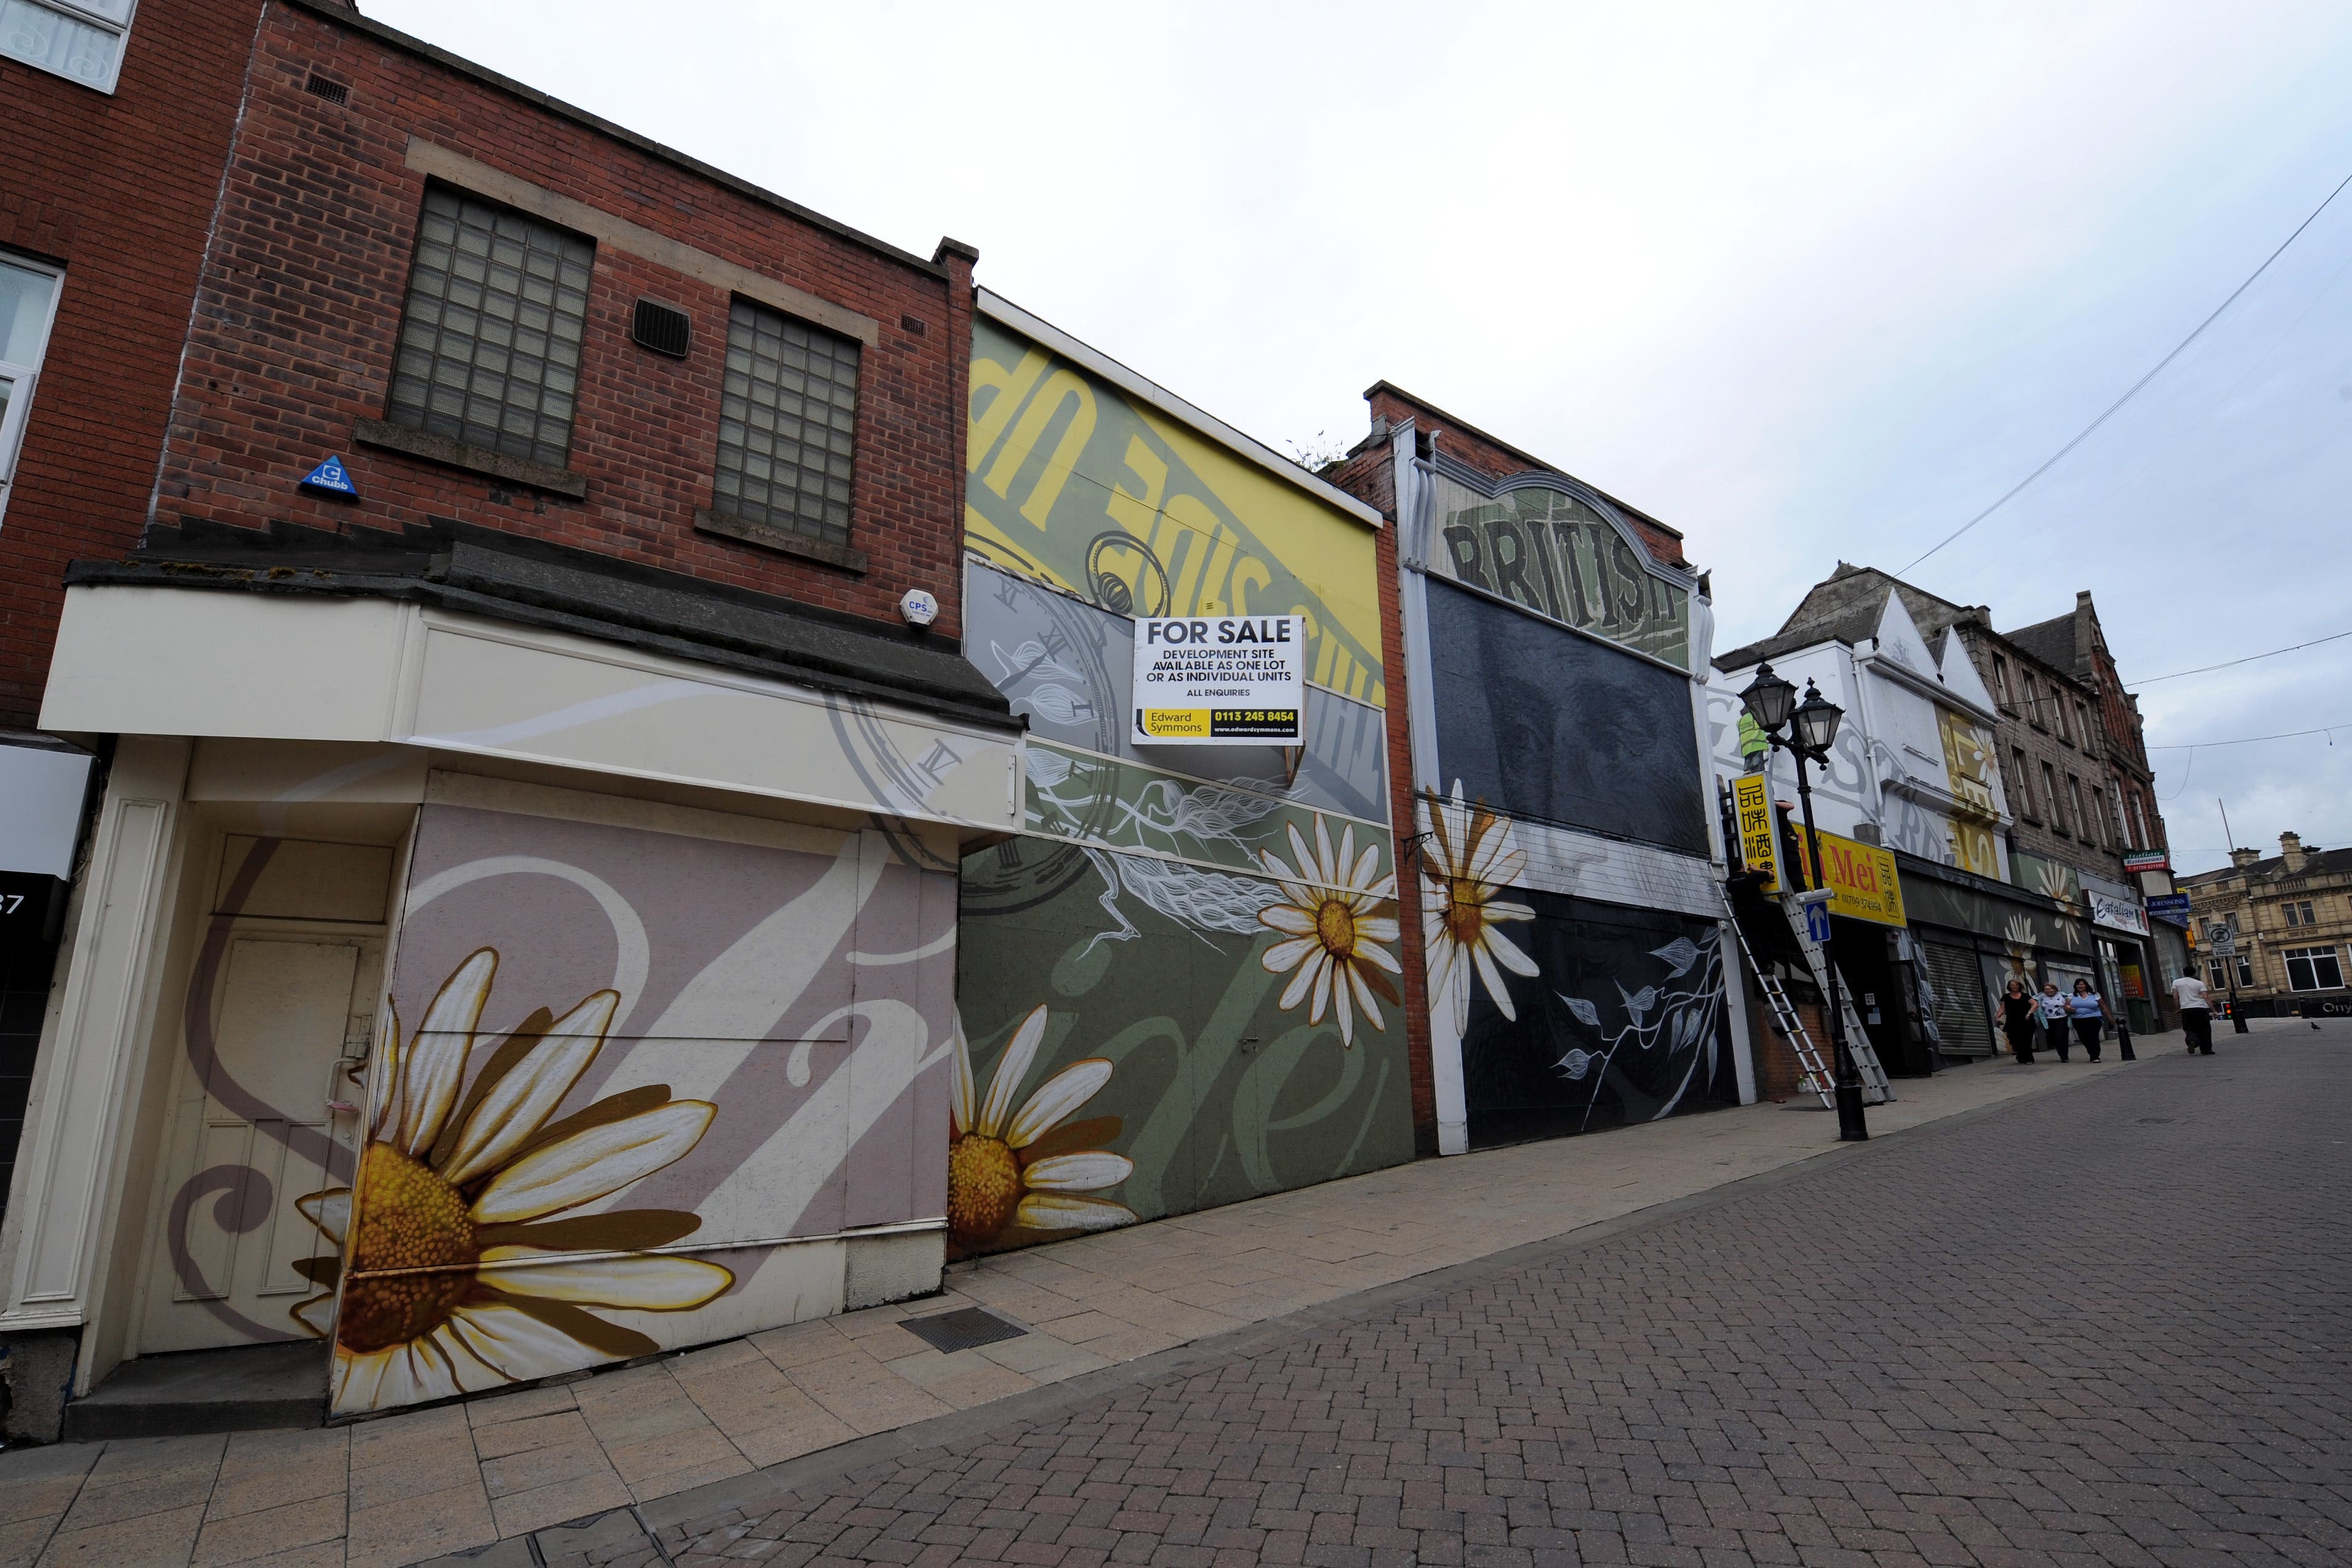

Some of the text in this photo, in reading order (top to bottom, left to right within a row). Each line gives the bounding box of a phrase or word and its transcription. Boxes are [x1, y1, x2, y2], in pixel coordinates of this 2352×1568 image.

[312, 475, 349, 490] Chubb
[909, 601, 927, 612] CPS
[1148, 619, 1291, 645] FOR SALE
[1163, 649, 1275, 659] DEVELOPMENT SITE
[1153, 660, 1286, 670] AVAILABLE AS ONE LOT
[1146, 672, 1291, 682] OR AS INDIVIDUAL UNITS
[1205, 689, 1251, 697] ENQUIRIES
[1151, 712, 1294, 722] Edward 0113 245 8454
[1151, 723, 1202, 733] Symmons
[1829, 845, 1879, 893] Mei
